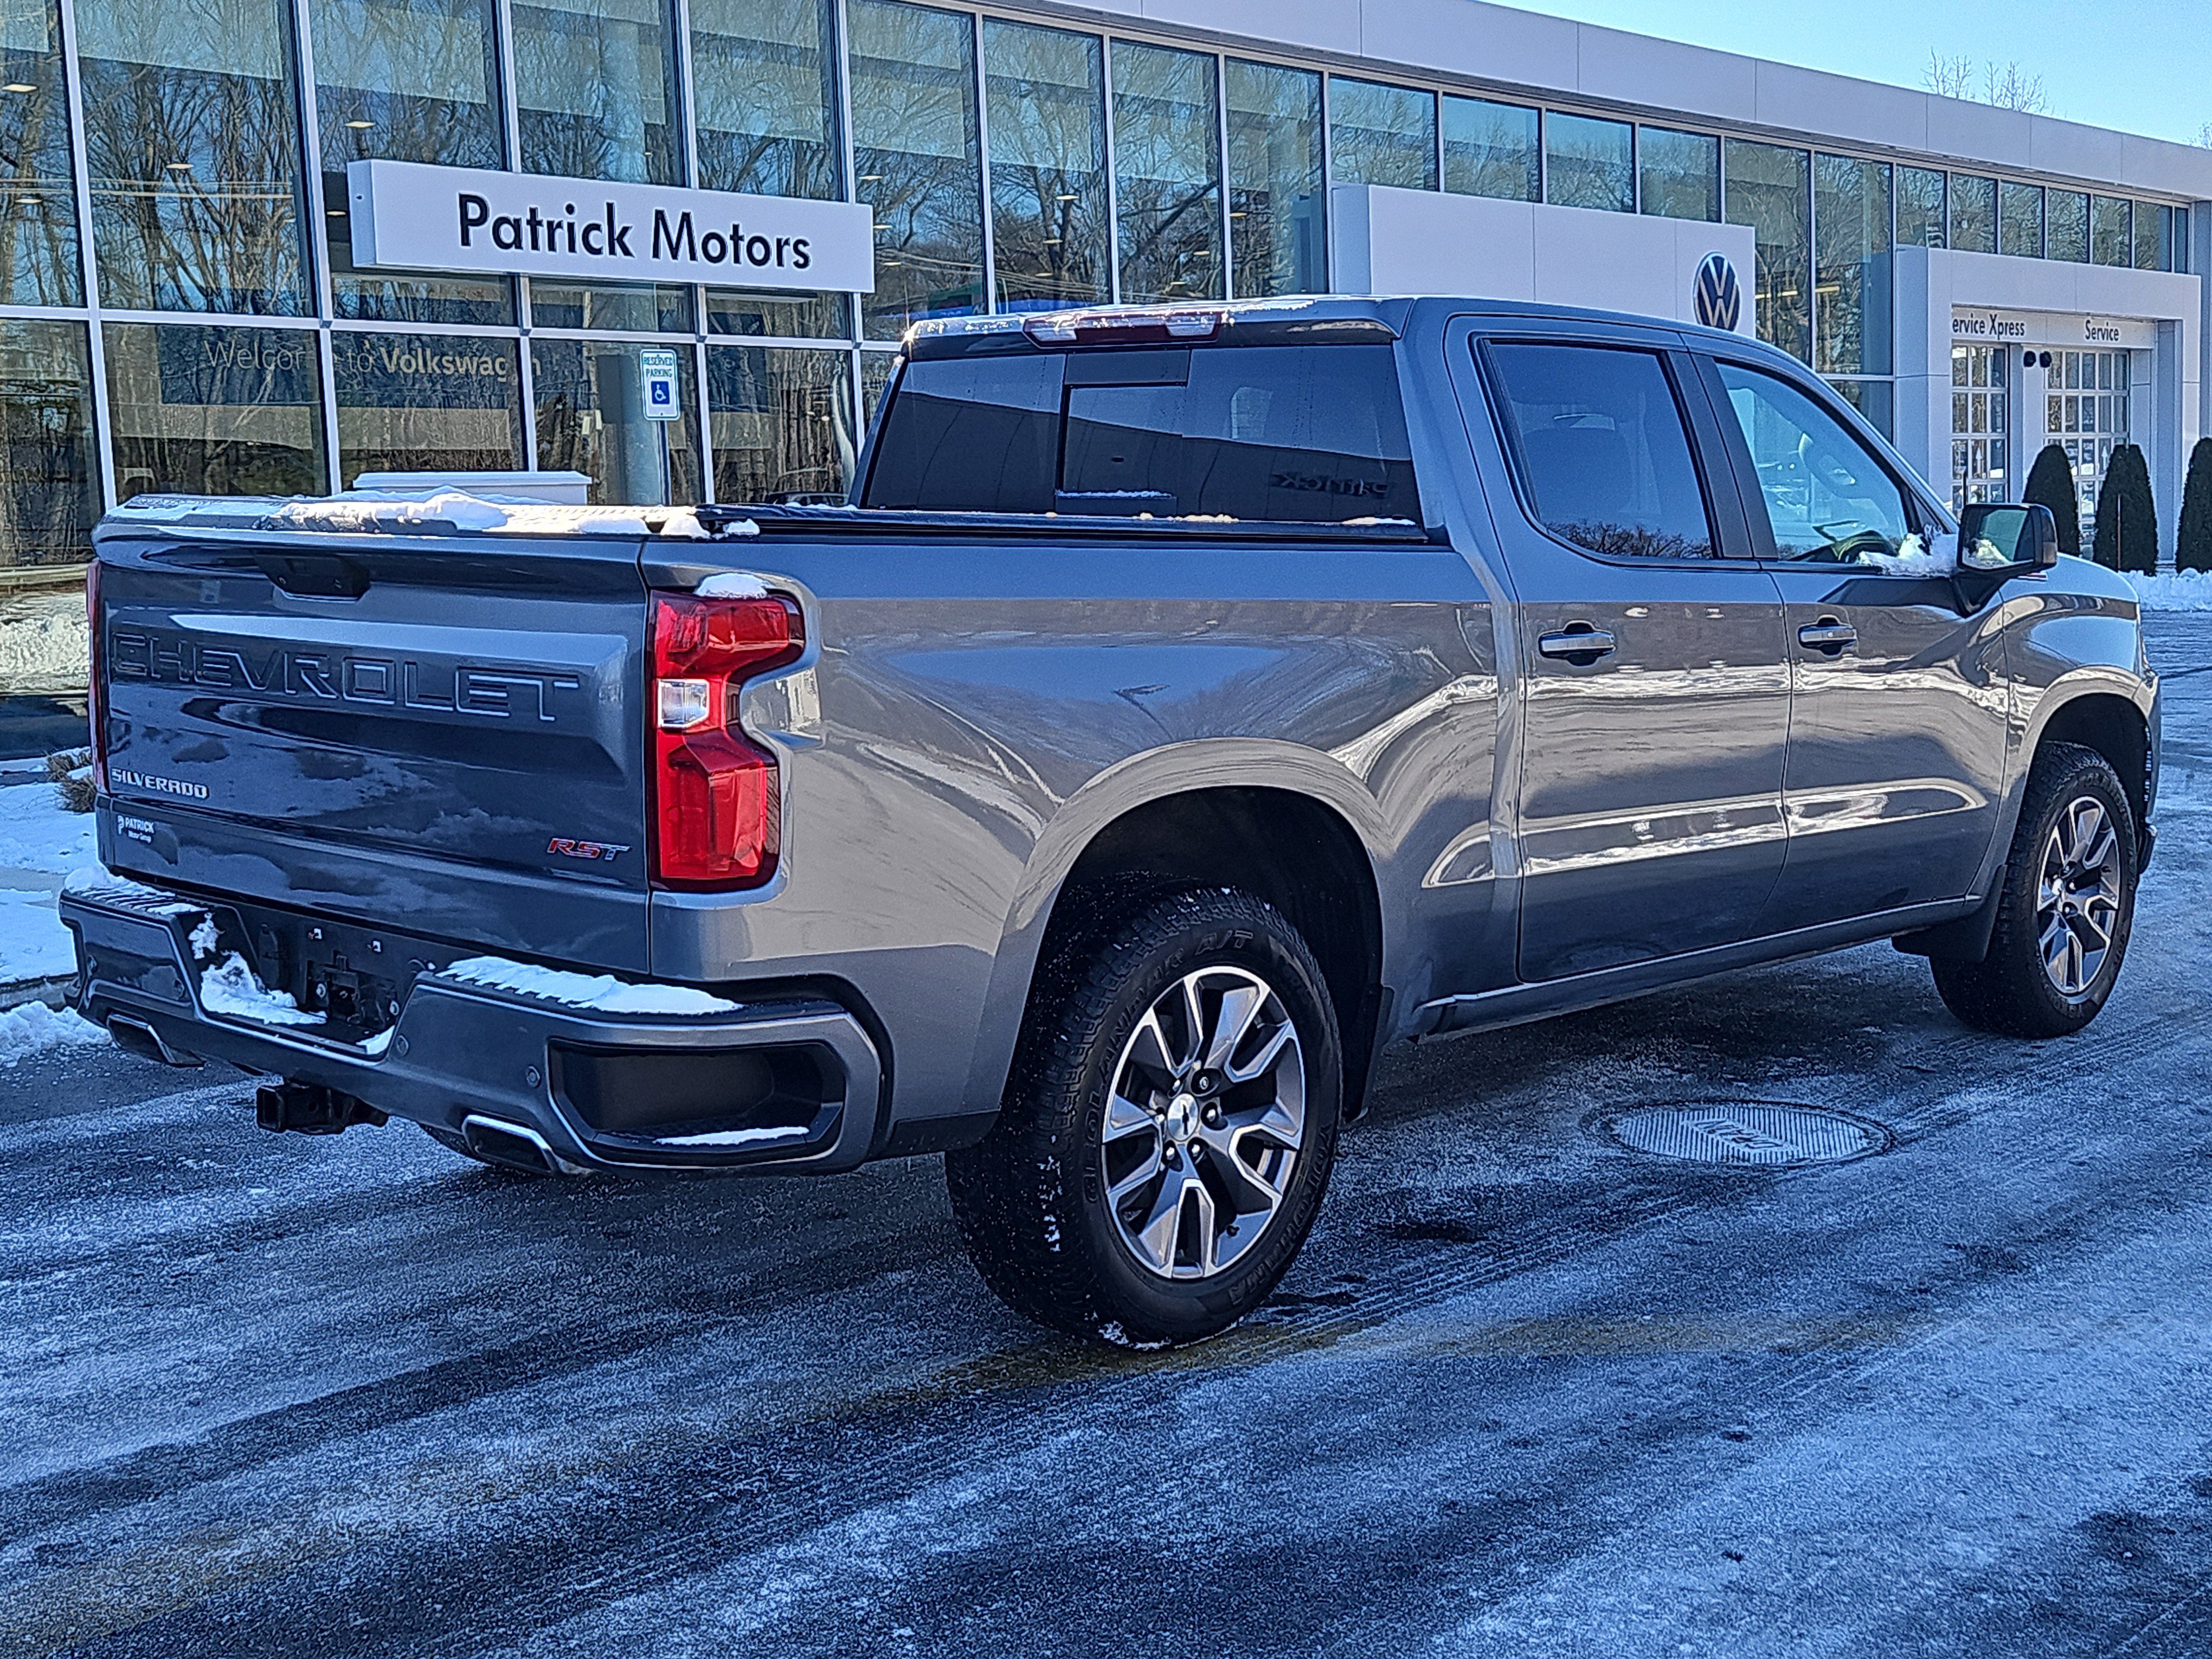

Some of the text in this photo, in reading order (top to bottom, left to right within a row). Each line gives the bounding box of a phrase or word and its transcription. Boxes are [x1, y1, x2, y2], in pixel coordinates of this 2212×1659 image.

[458, 192, 811, 269] Patrick Motors
[1952, 313, 2025, 340] ervice Xpress
[2085, 320, 2119, 341] Service
[203, 340, 541, 382] Welco to Volkswagn
[111, 632, 579, 722] CHEVROLET
[112, 768, 208, 799] SILVERADO
[125, 817, 155, 834] PATRICK
[547, 838, 632, 861] RST
